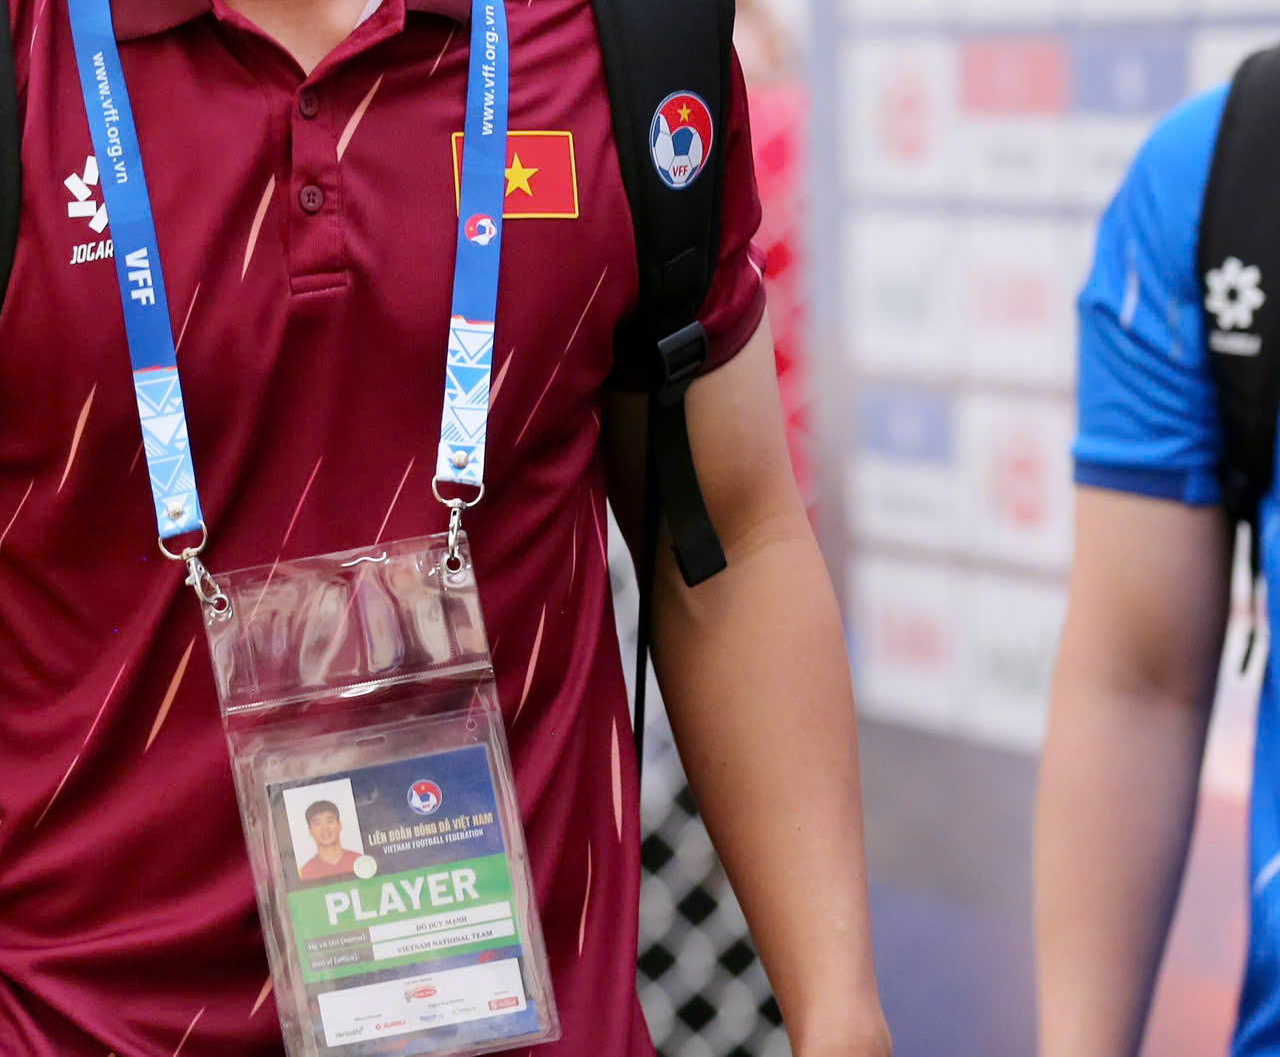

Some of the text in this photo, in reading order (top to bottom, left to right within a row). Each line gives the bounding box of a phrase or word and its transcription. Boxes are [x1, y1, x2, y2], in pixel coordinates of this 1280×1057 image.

[481, 4, 499, 136] www.vff.org.vn
[92, 50, 129, 185] www.vff.org.vn
[672, 164, 689, 178] VFF
[69, 239, 115, 265] JOGAR
[125, 246, 156, 306] VFF
[472, 812, 494, 827] NAM
[383, 828, 485, 855] VIETNAM FOOTBALL FEDERATION
[324, 867, 481, 926] PLAYER
[397, 929, 493, 954] VIETNAM NATIONAL TEAM
